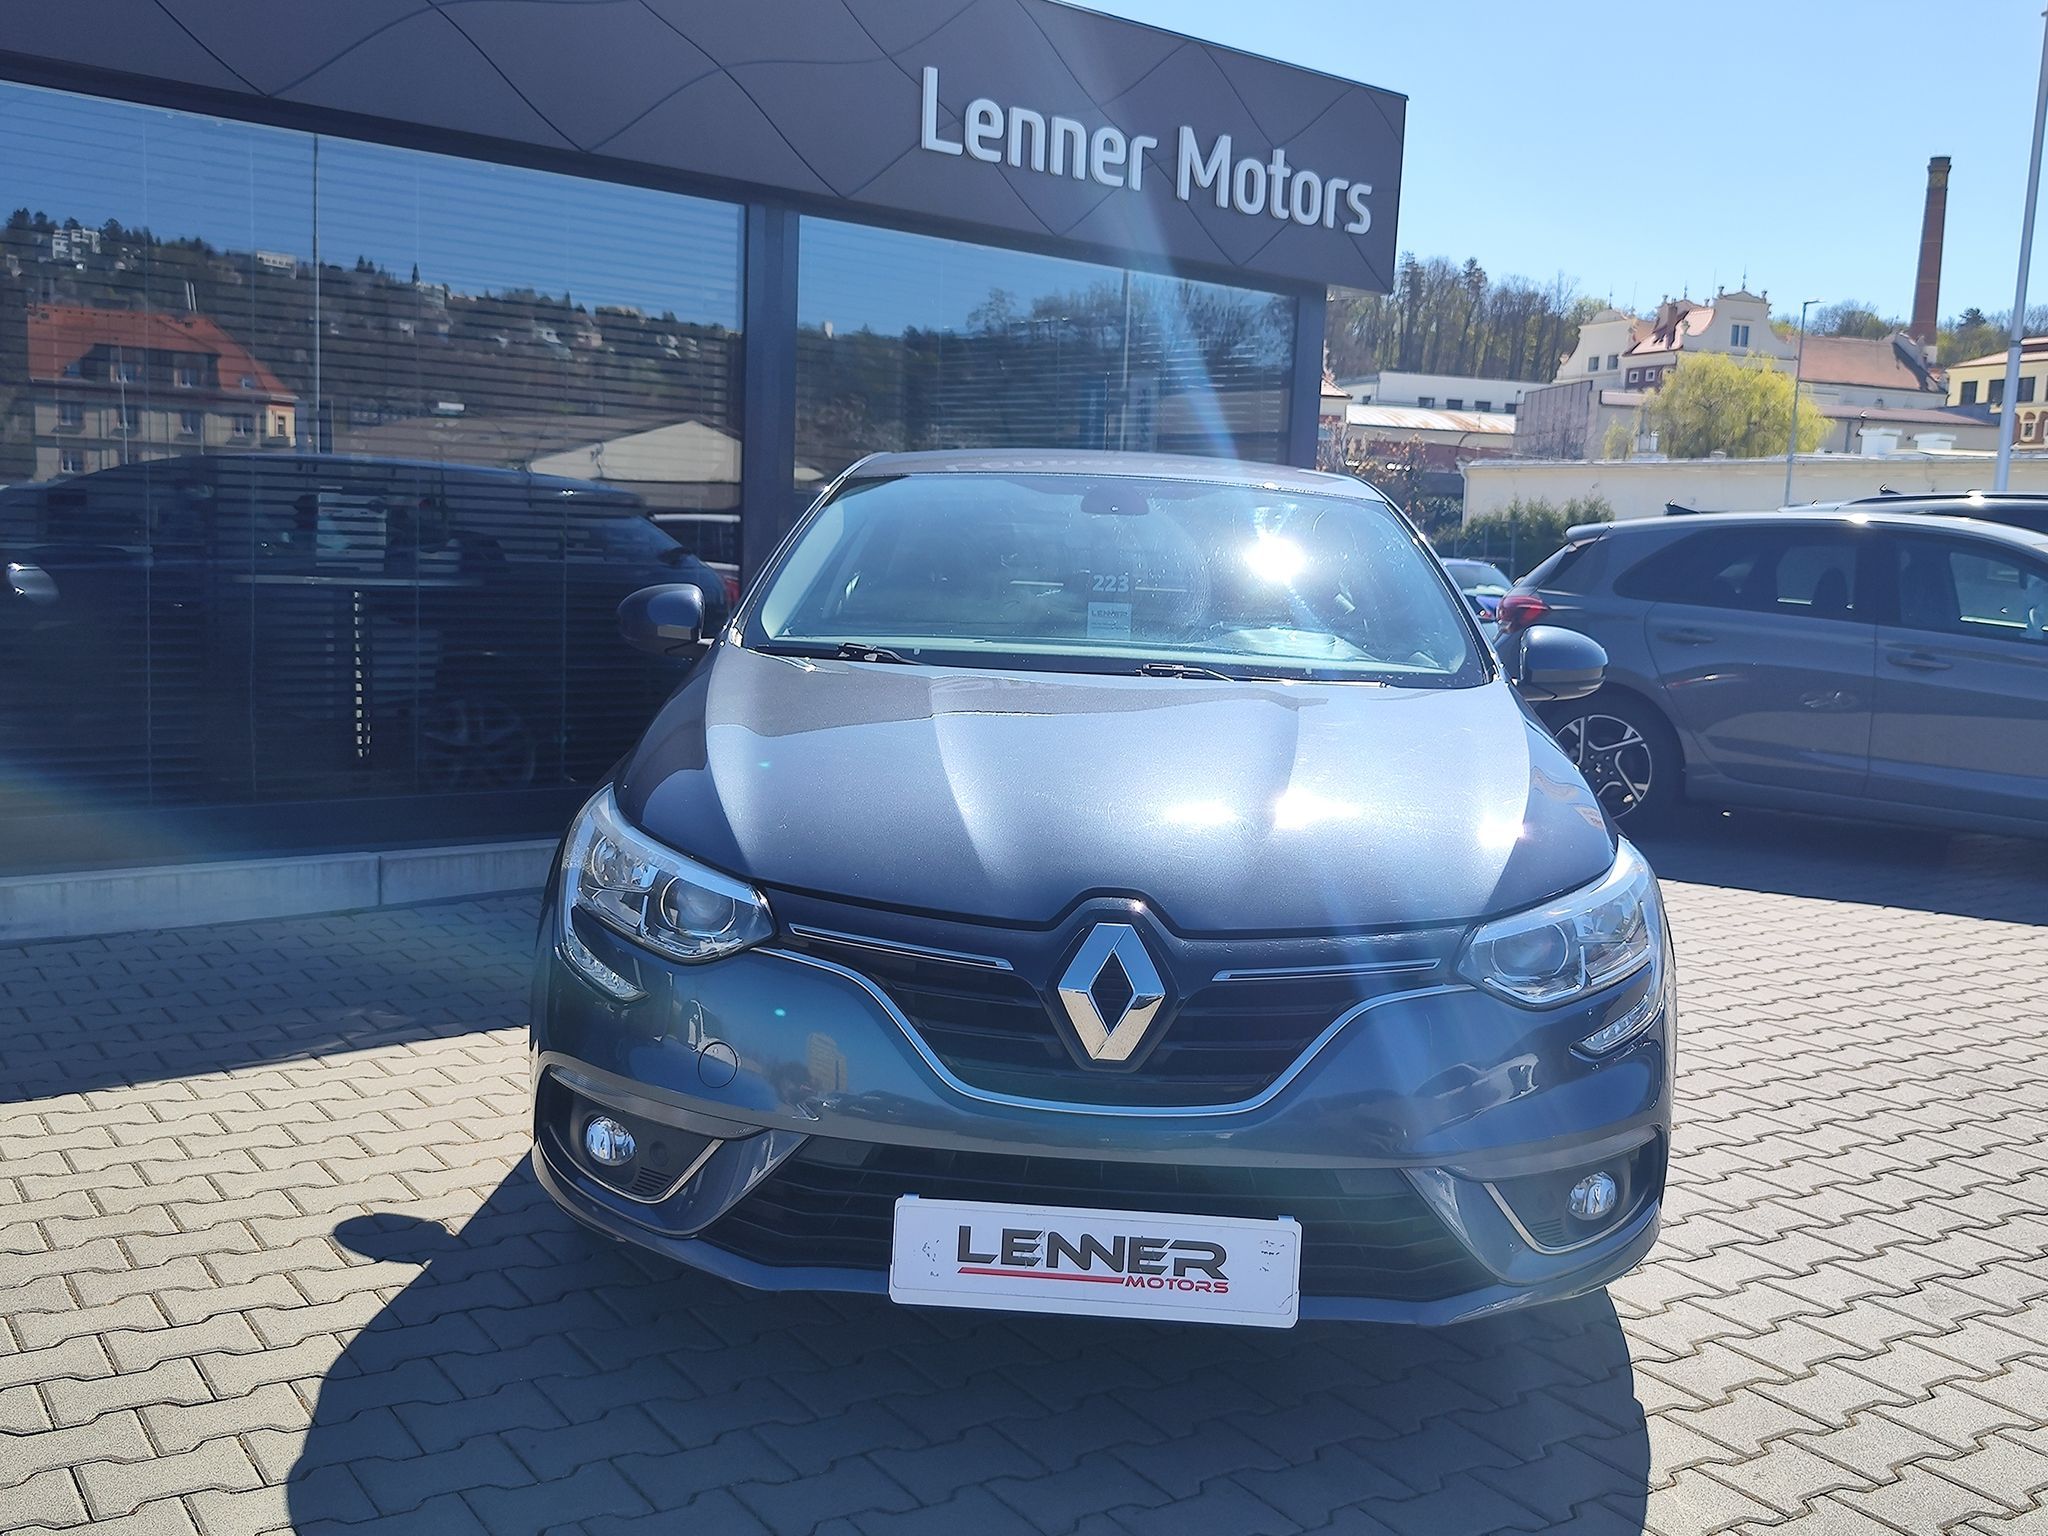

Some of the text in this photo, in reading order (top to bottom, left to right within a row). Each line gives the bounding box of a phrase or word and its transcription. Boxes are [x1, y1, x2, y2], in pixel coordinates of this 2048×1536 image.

[921, 66, 1372, 235] Lenner Motors
[1092, 574, 1130, 592] 223
[957, 1225, 1229, 1280] LENNER
[1123, 1275, 1230, 1294] MOTORS
